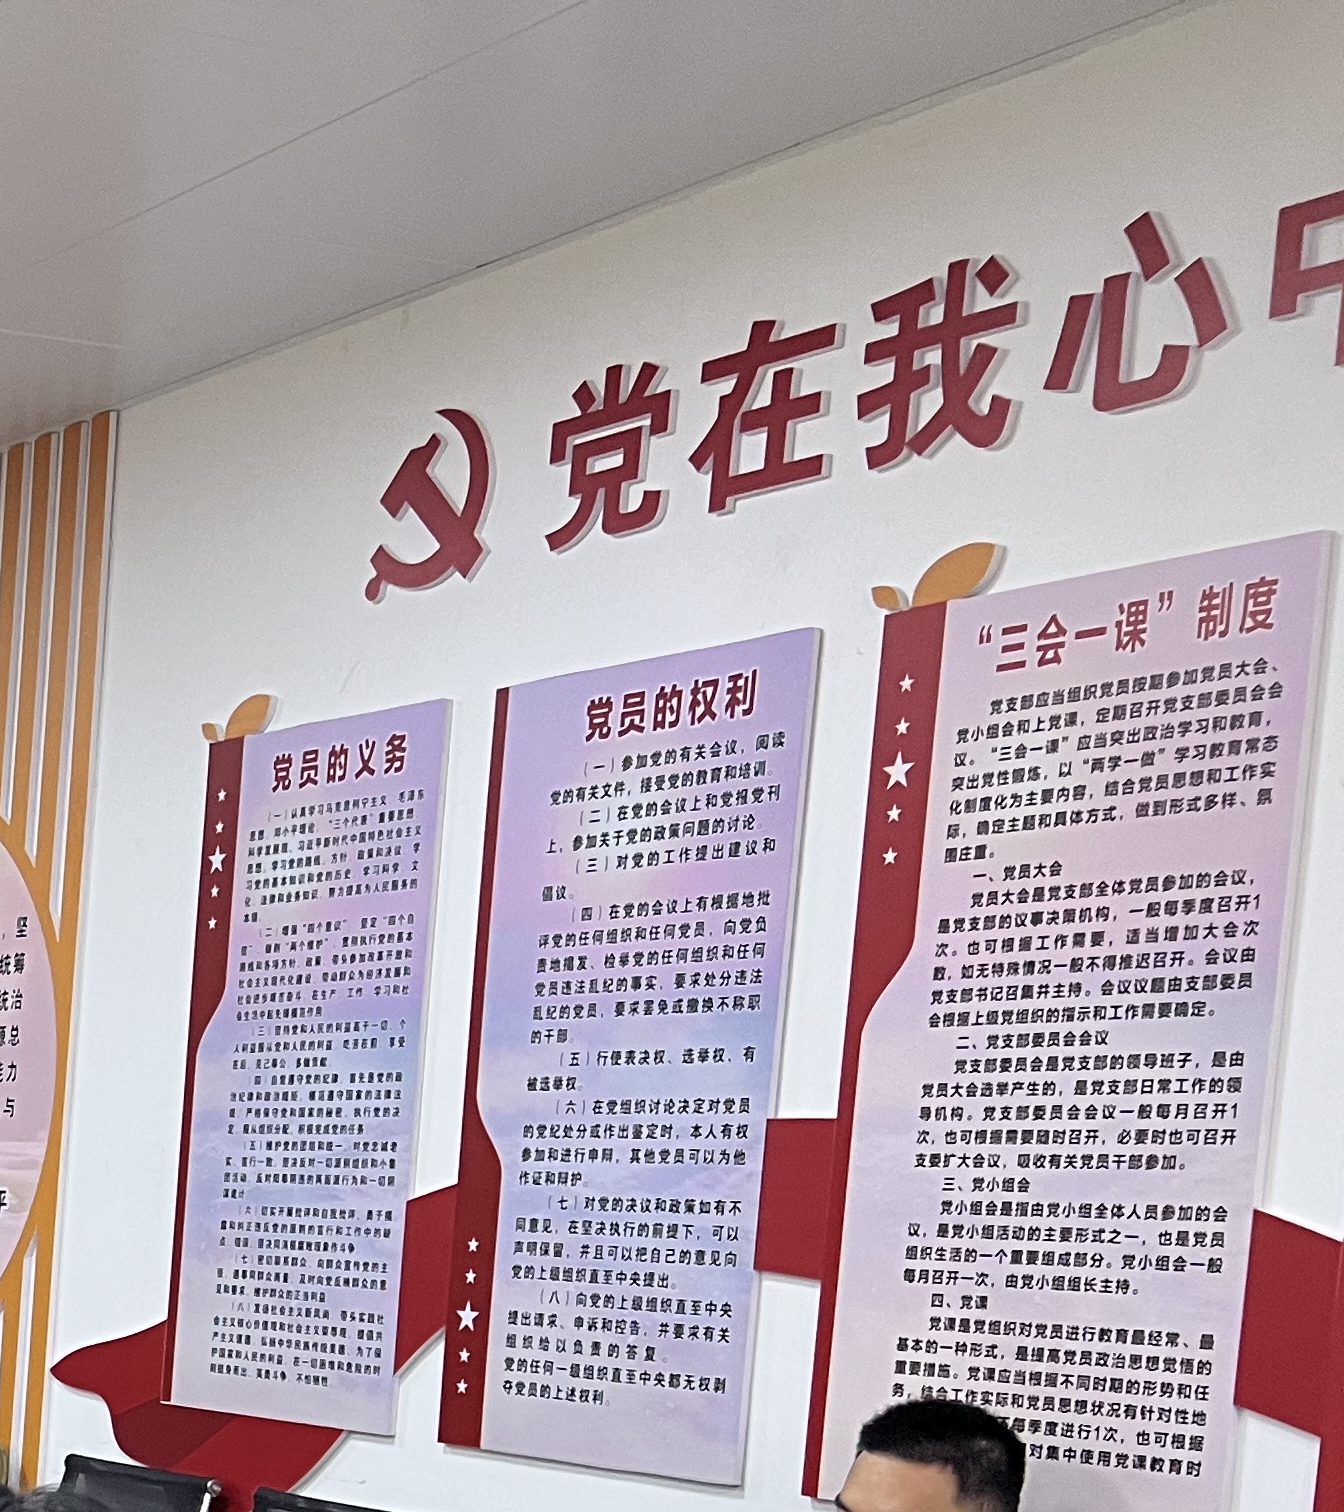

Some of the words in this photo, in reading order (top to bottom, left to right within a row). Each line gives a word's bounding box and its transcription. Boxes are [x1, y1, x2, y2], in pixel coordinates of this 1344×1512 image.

[585, 669, 758, 742] 党员的权利
[271, 733, 408, 792] 党员的义务
[973, 861, 1062, 882] 一、党员大会
[957, 1030, 1109, 1050] 二、党支部委员会会议
[942, 1177, 1030, 1193] 三、党小组会
[930, 1293, 988, 1310] 四、党课
